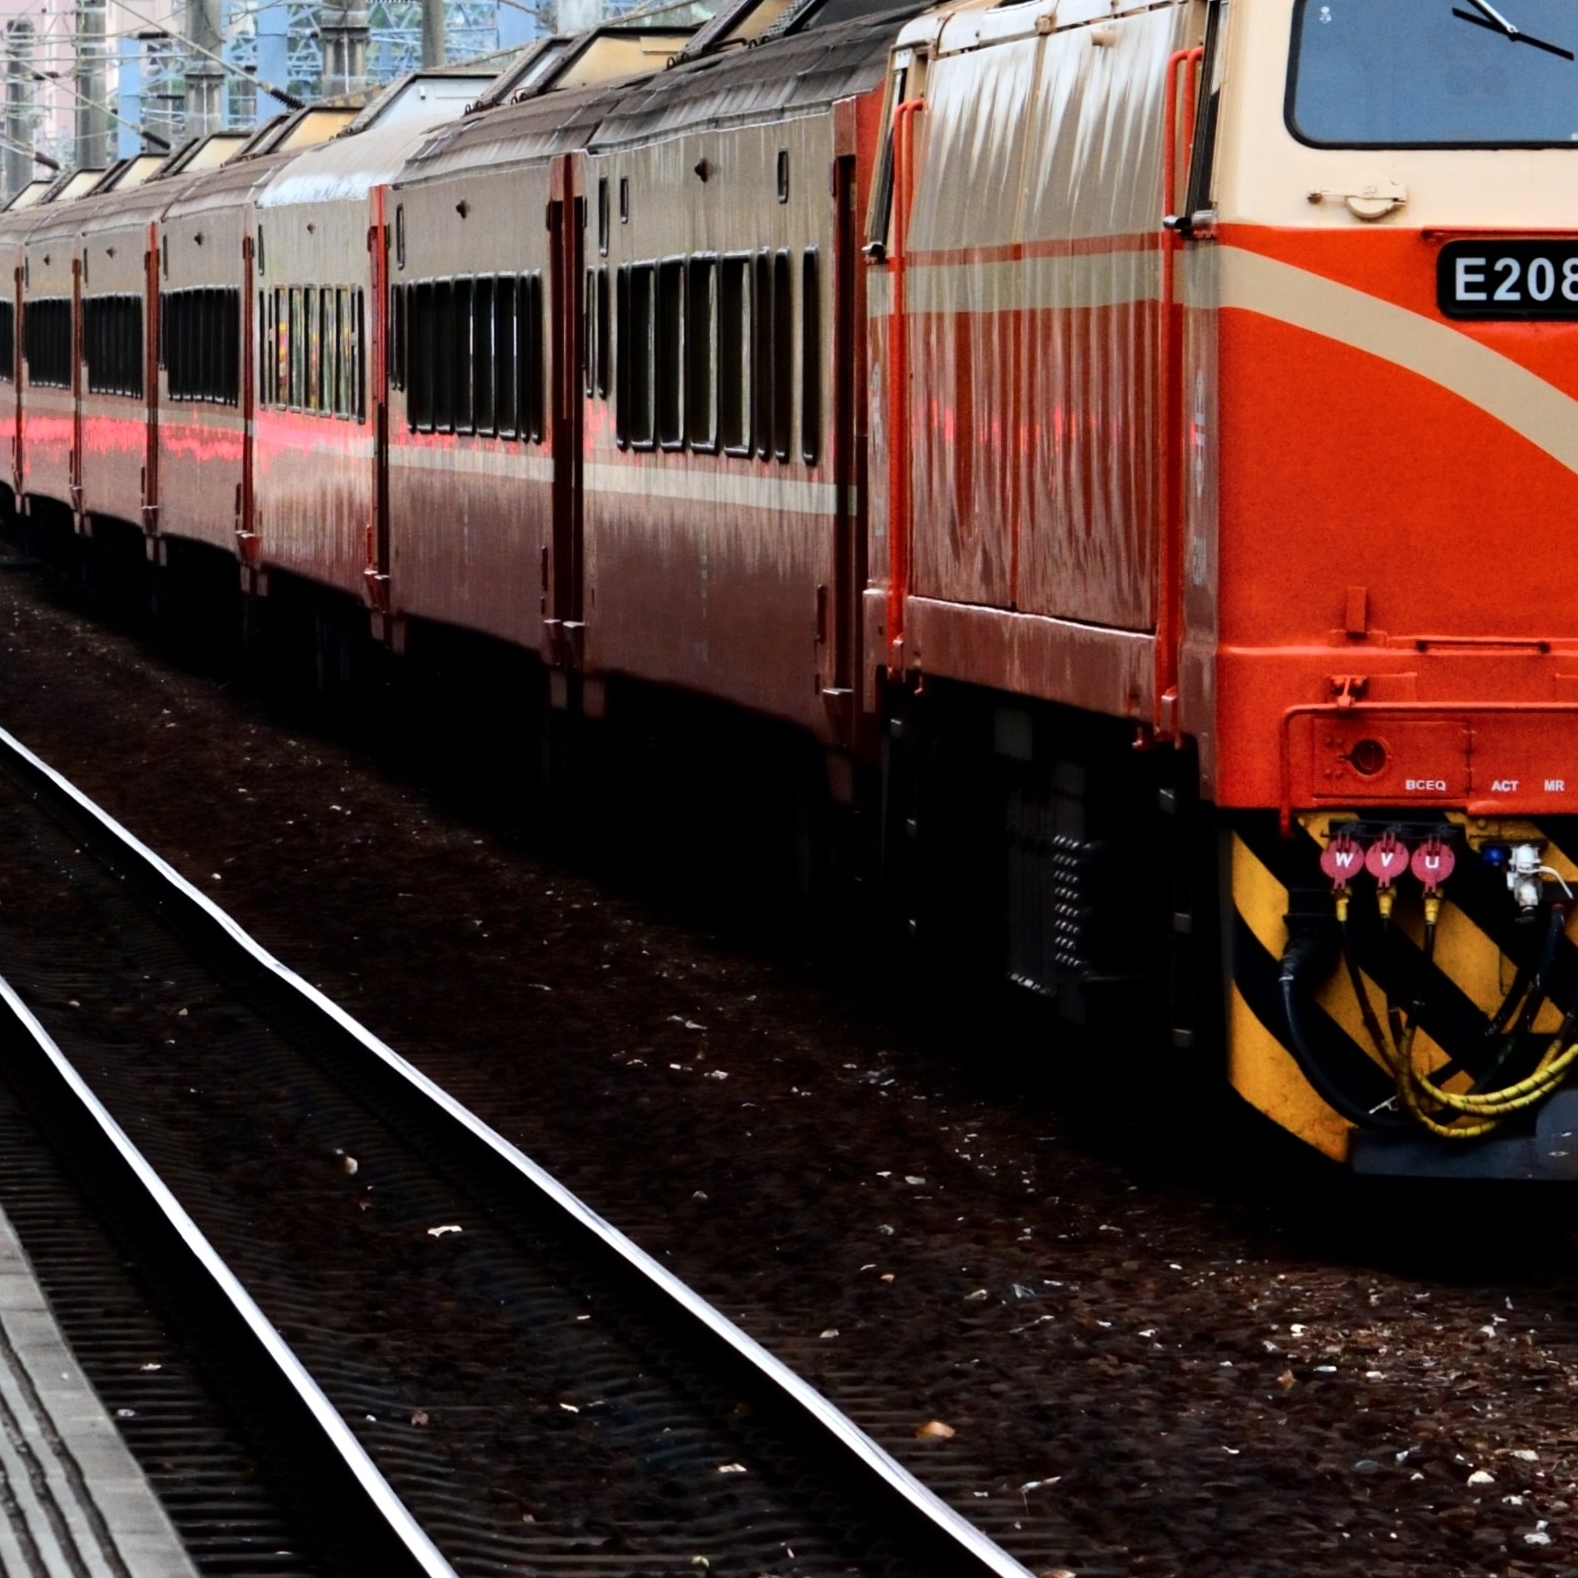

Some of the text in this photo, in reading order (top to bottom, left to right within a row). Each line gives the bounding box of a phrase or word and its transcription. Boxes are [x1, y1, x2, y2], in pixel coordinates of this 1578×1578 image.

[1405, 779, 1446, 792] BCEQ
[1491, 780, 1519, 792] ACT
[1544, 780, 1565, 792] MR
[1335, 852, 1353, 868] W
[1380, 852, 1394, 868] V
